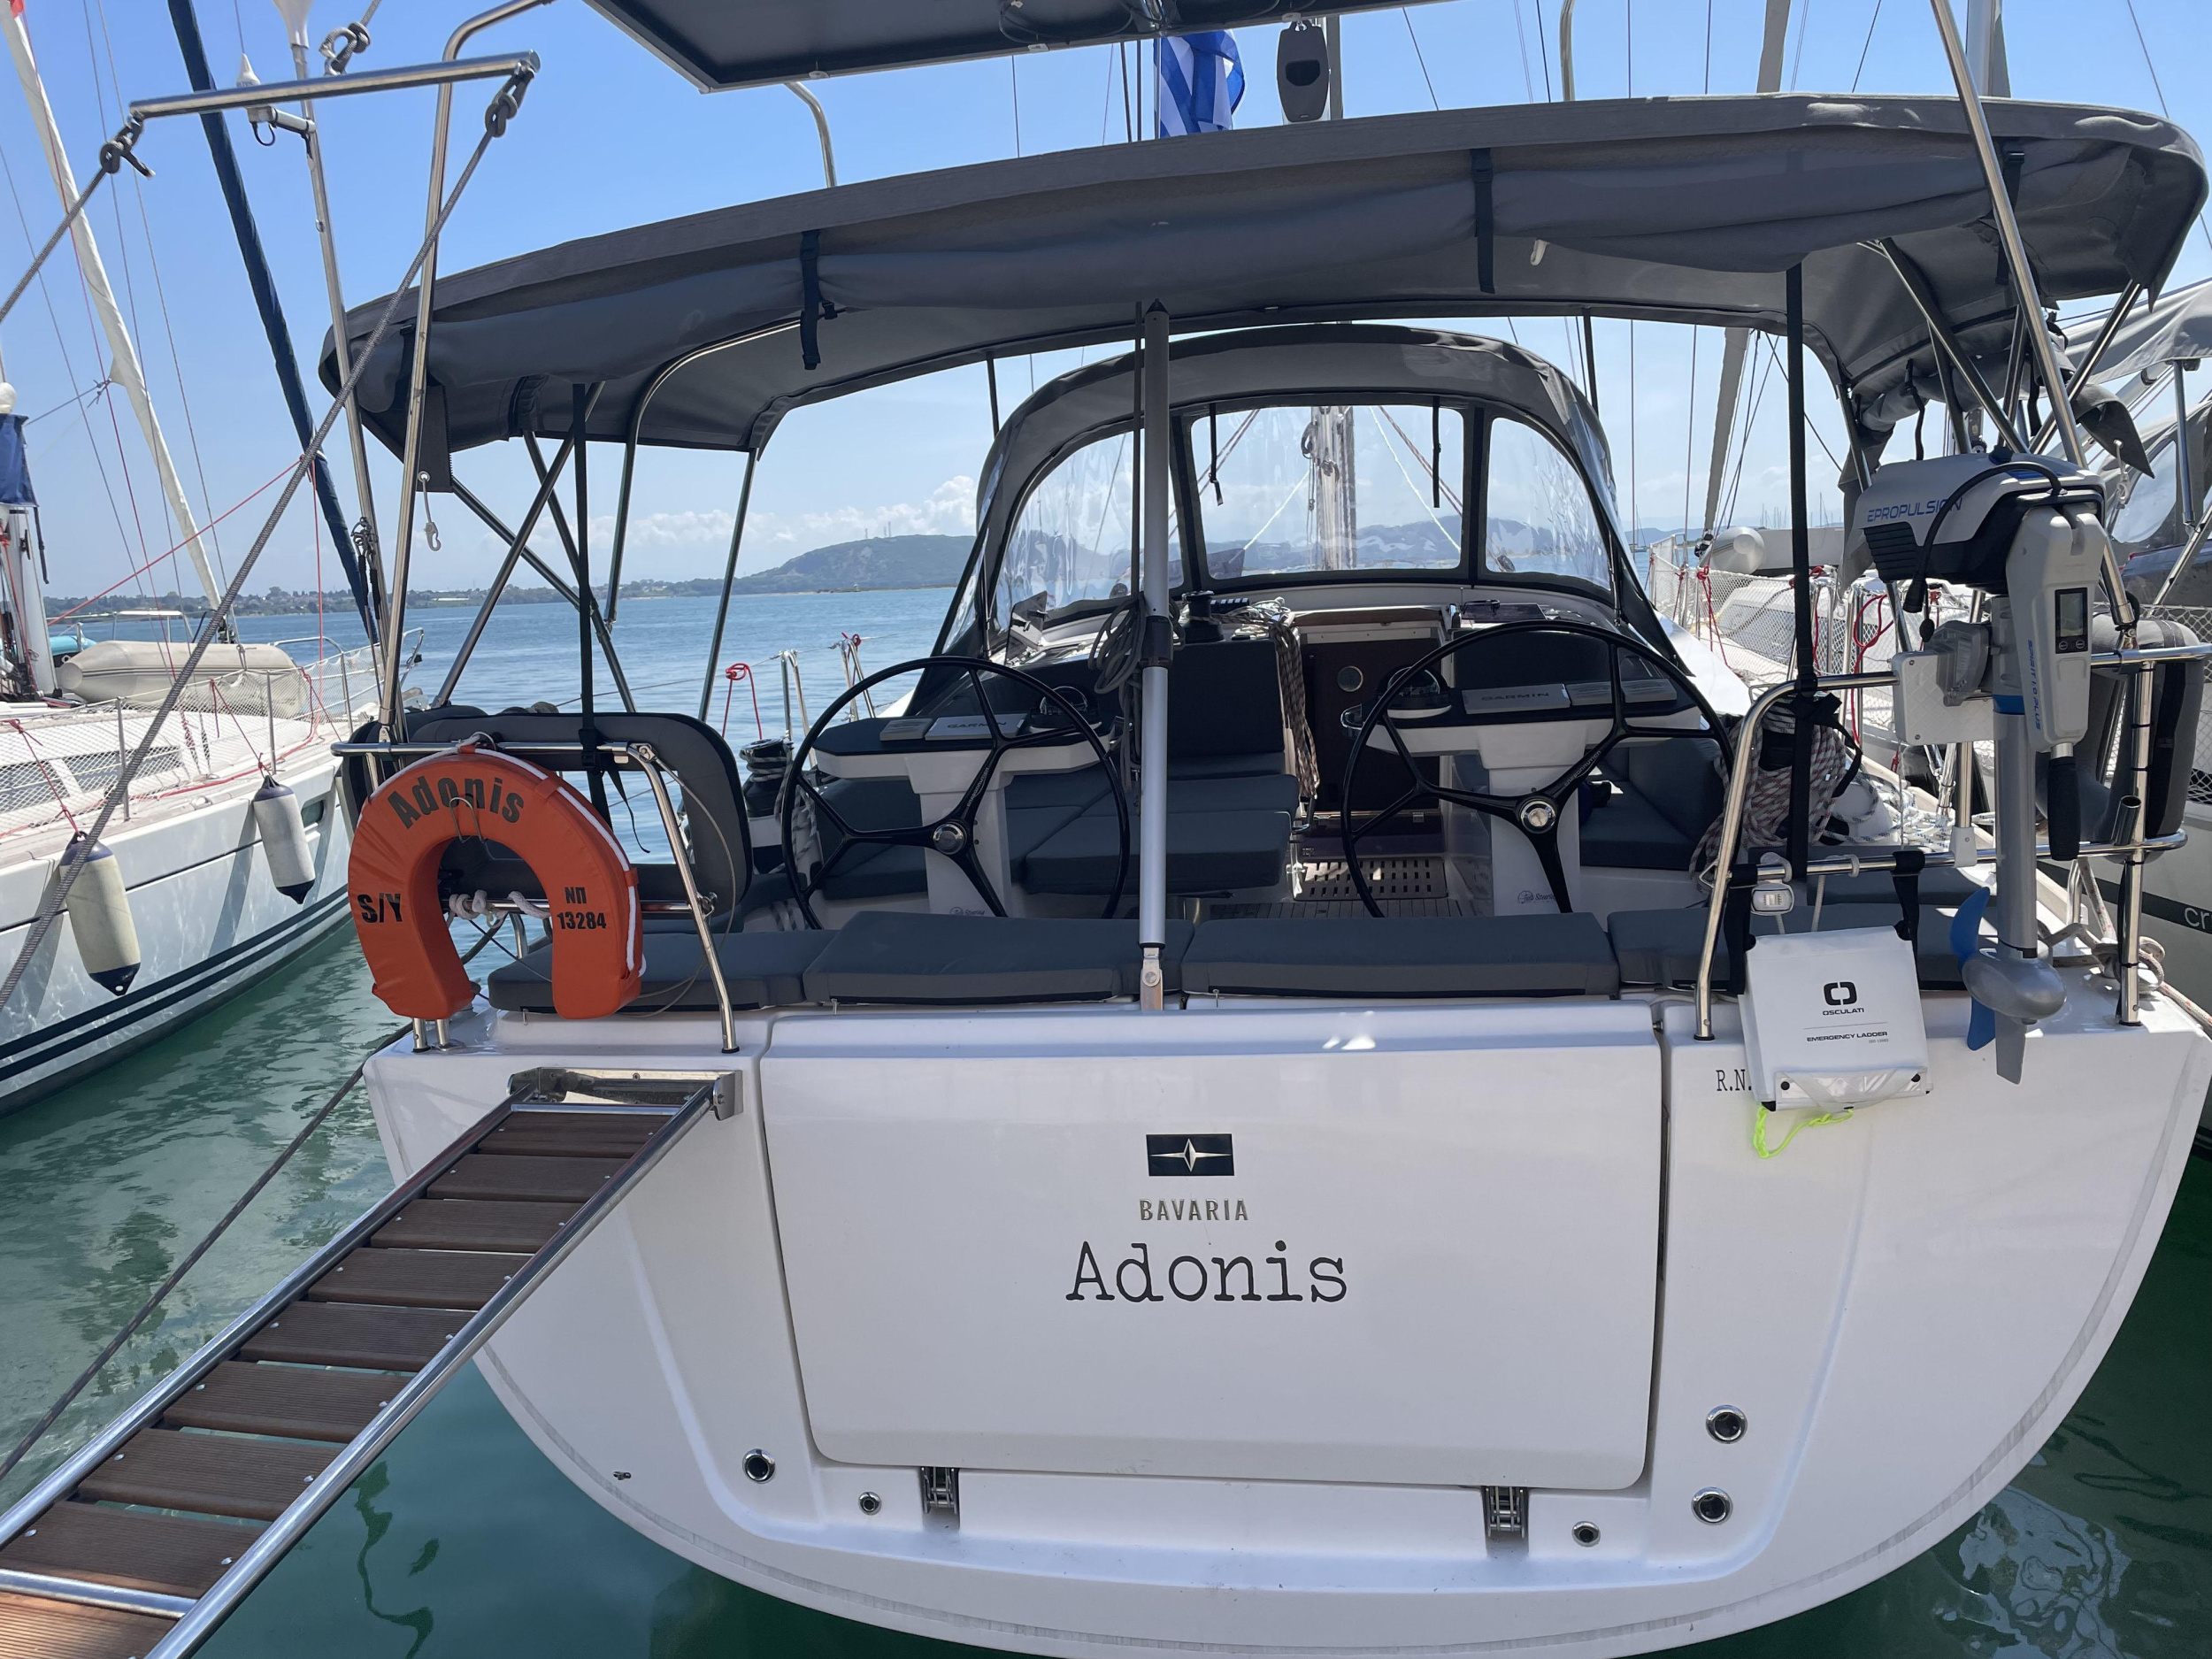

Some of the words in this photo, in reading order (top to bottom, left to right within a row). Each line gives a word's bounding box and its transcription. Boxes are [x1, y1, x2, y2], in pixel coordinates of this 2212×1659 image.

[1481, 692, 1549, 701] GARMIN
[387, 775, 525, 830] Adonis
[357, 892, 403, 924] S/Y
[2184, 907, 2212, 930] cr
[557, 911, 607, 930] 13284
[1823, 1007, 1865, 1016] OSCULATI
[1807, 1033, 1855, 1042] EMERGENCY
[1715, 1069, 1752, 1092] R.N.
[1139, 1198, 1249, 1221] BAVARIA
[1065, 1240, 1348, 1302] Adonis
